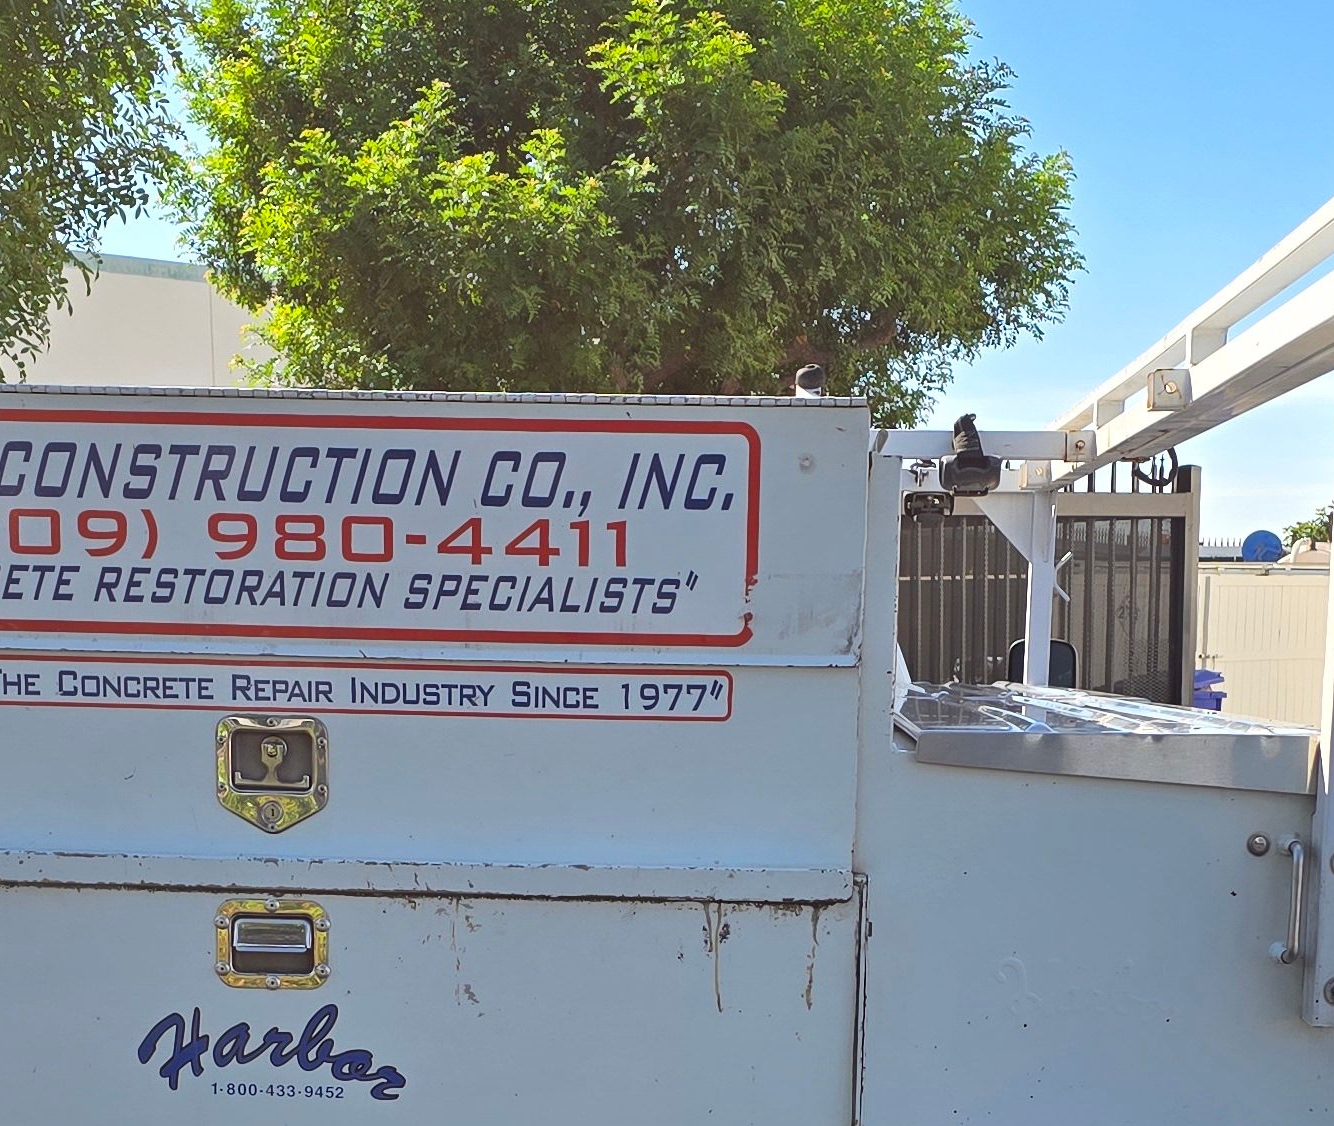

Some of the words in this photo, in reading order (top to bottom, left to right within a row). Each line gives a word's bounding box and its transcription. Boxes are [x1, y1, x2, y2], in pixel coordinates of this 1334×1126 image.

[480, 451, 592, 517] CO.,
[617, 453, 734, 511] INC.
[207, 512, 627, 567] 980-4411
[93, 566, 390, 609] RESTORATION
[403, 570, 699, 615] SPECIALISTS"
[621, 680, 724, 712] 1977"
